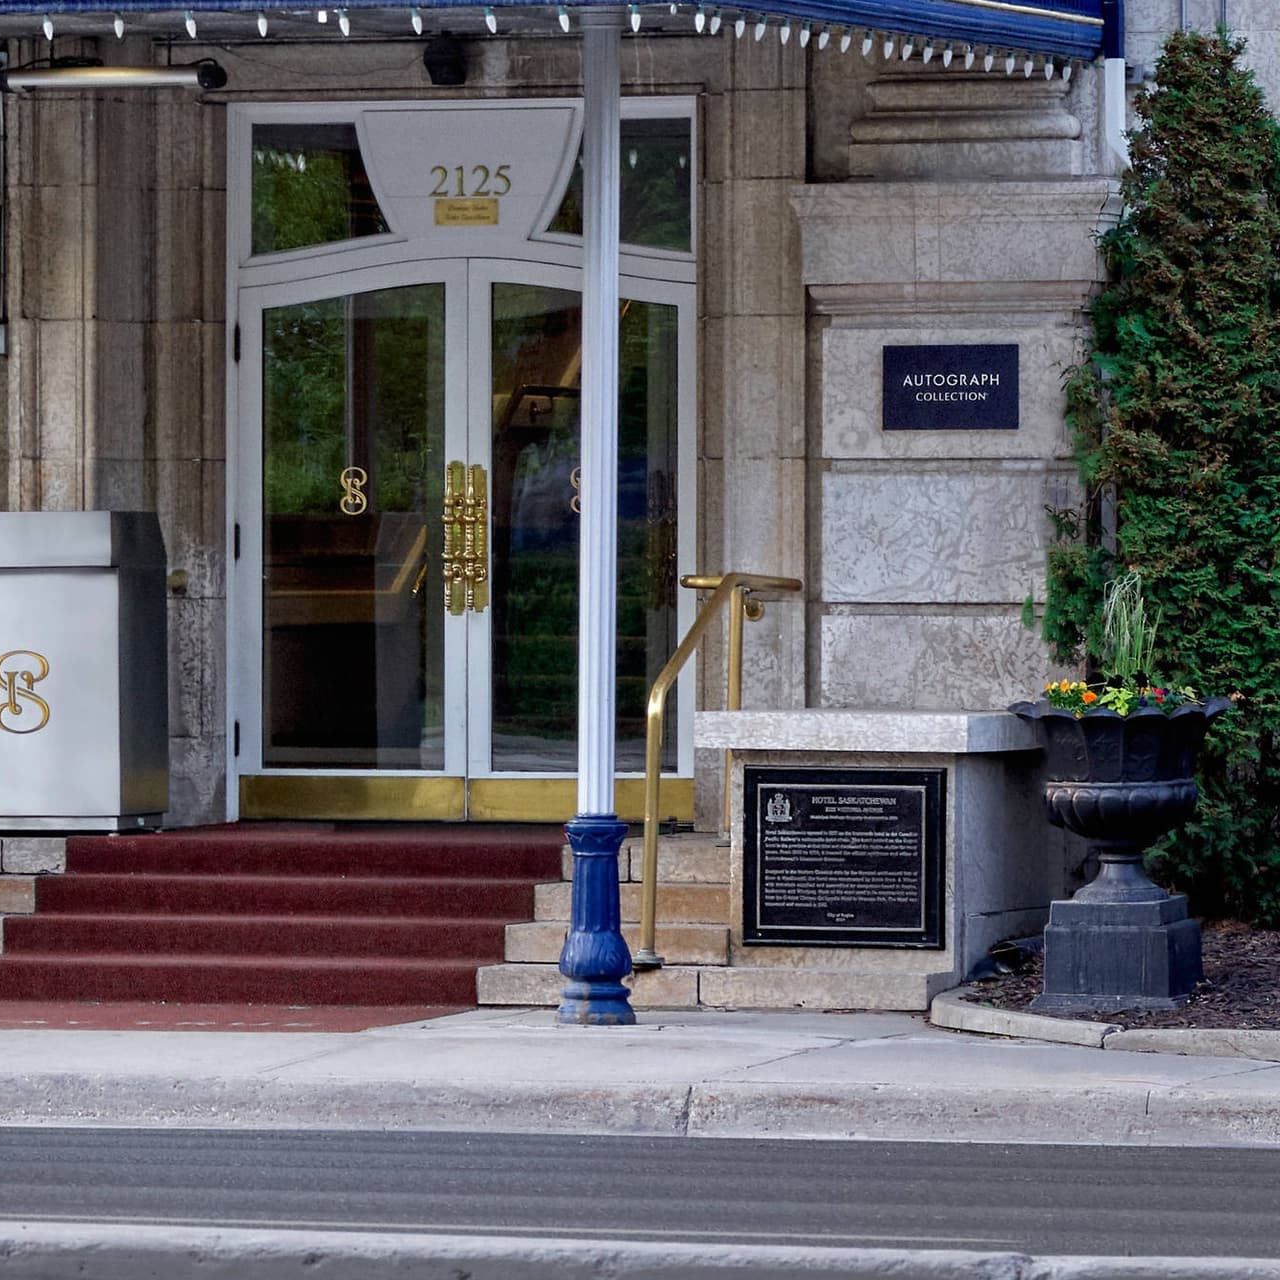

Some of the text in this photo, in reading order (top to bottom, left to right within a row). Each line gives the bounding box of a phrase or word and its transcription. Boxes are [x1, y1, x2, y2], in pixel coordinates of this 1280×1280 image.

[428, 164, 512, 198] 2125
[902, 373, 1001, 387] AUTOGRAPH
[915, 392, 988, 402] COLLECTION
[811, 796, 837, 804] HOTEL
